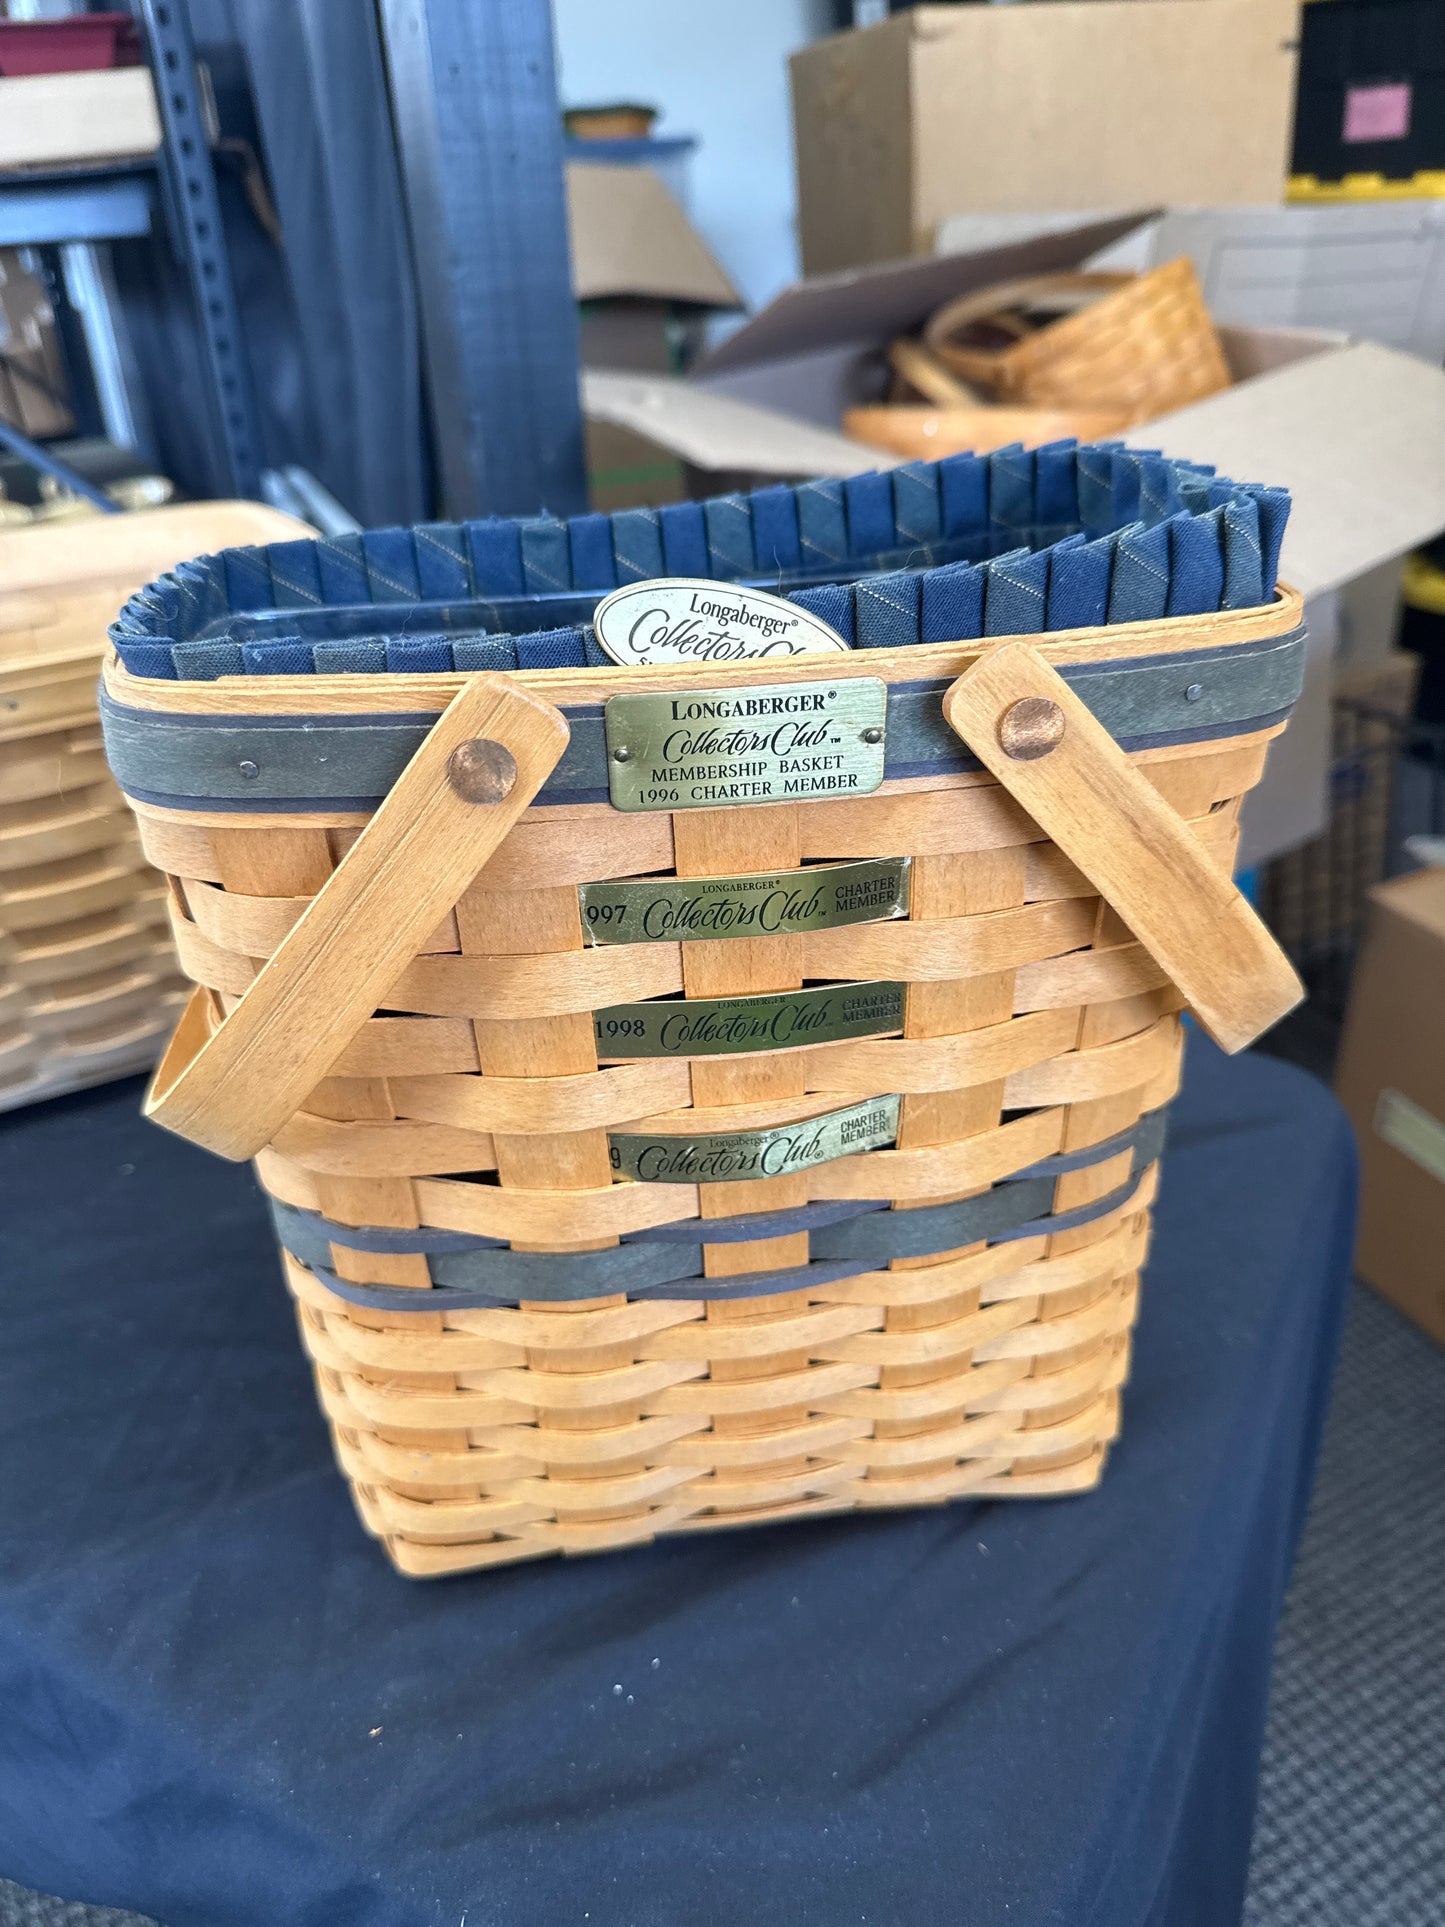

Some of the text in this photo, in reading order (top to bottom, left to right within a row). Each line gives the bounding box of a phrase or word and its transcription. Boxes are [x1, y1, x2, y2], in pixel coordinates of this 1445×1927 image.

[628, 608, 758, 660] Collectors
[663, 727, 771, 763] Collectors
[651, 755, 844, 782] MEMBERSHIP BASKET
[638, 774, 858, 804] 1996 CHARTER MEMBER
[835, 876, 895, 899] CHARTER
[835, 890, 895, 912] MEMBER
[643, 896, 759, 939] Collectors
[842, 992, 901, 1011] CHARTER
[842, 1004, 901, 1022] MEMBER
[595, 1019, 646, 1039] 1998
[660, 1012, 770, 1050] Collectors
[840, 1109, 886, 1133] CHARTER
[840, 1120, 887, 1145] MEMBER
[637, 1145, 761, 1181] Collectors
